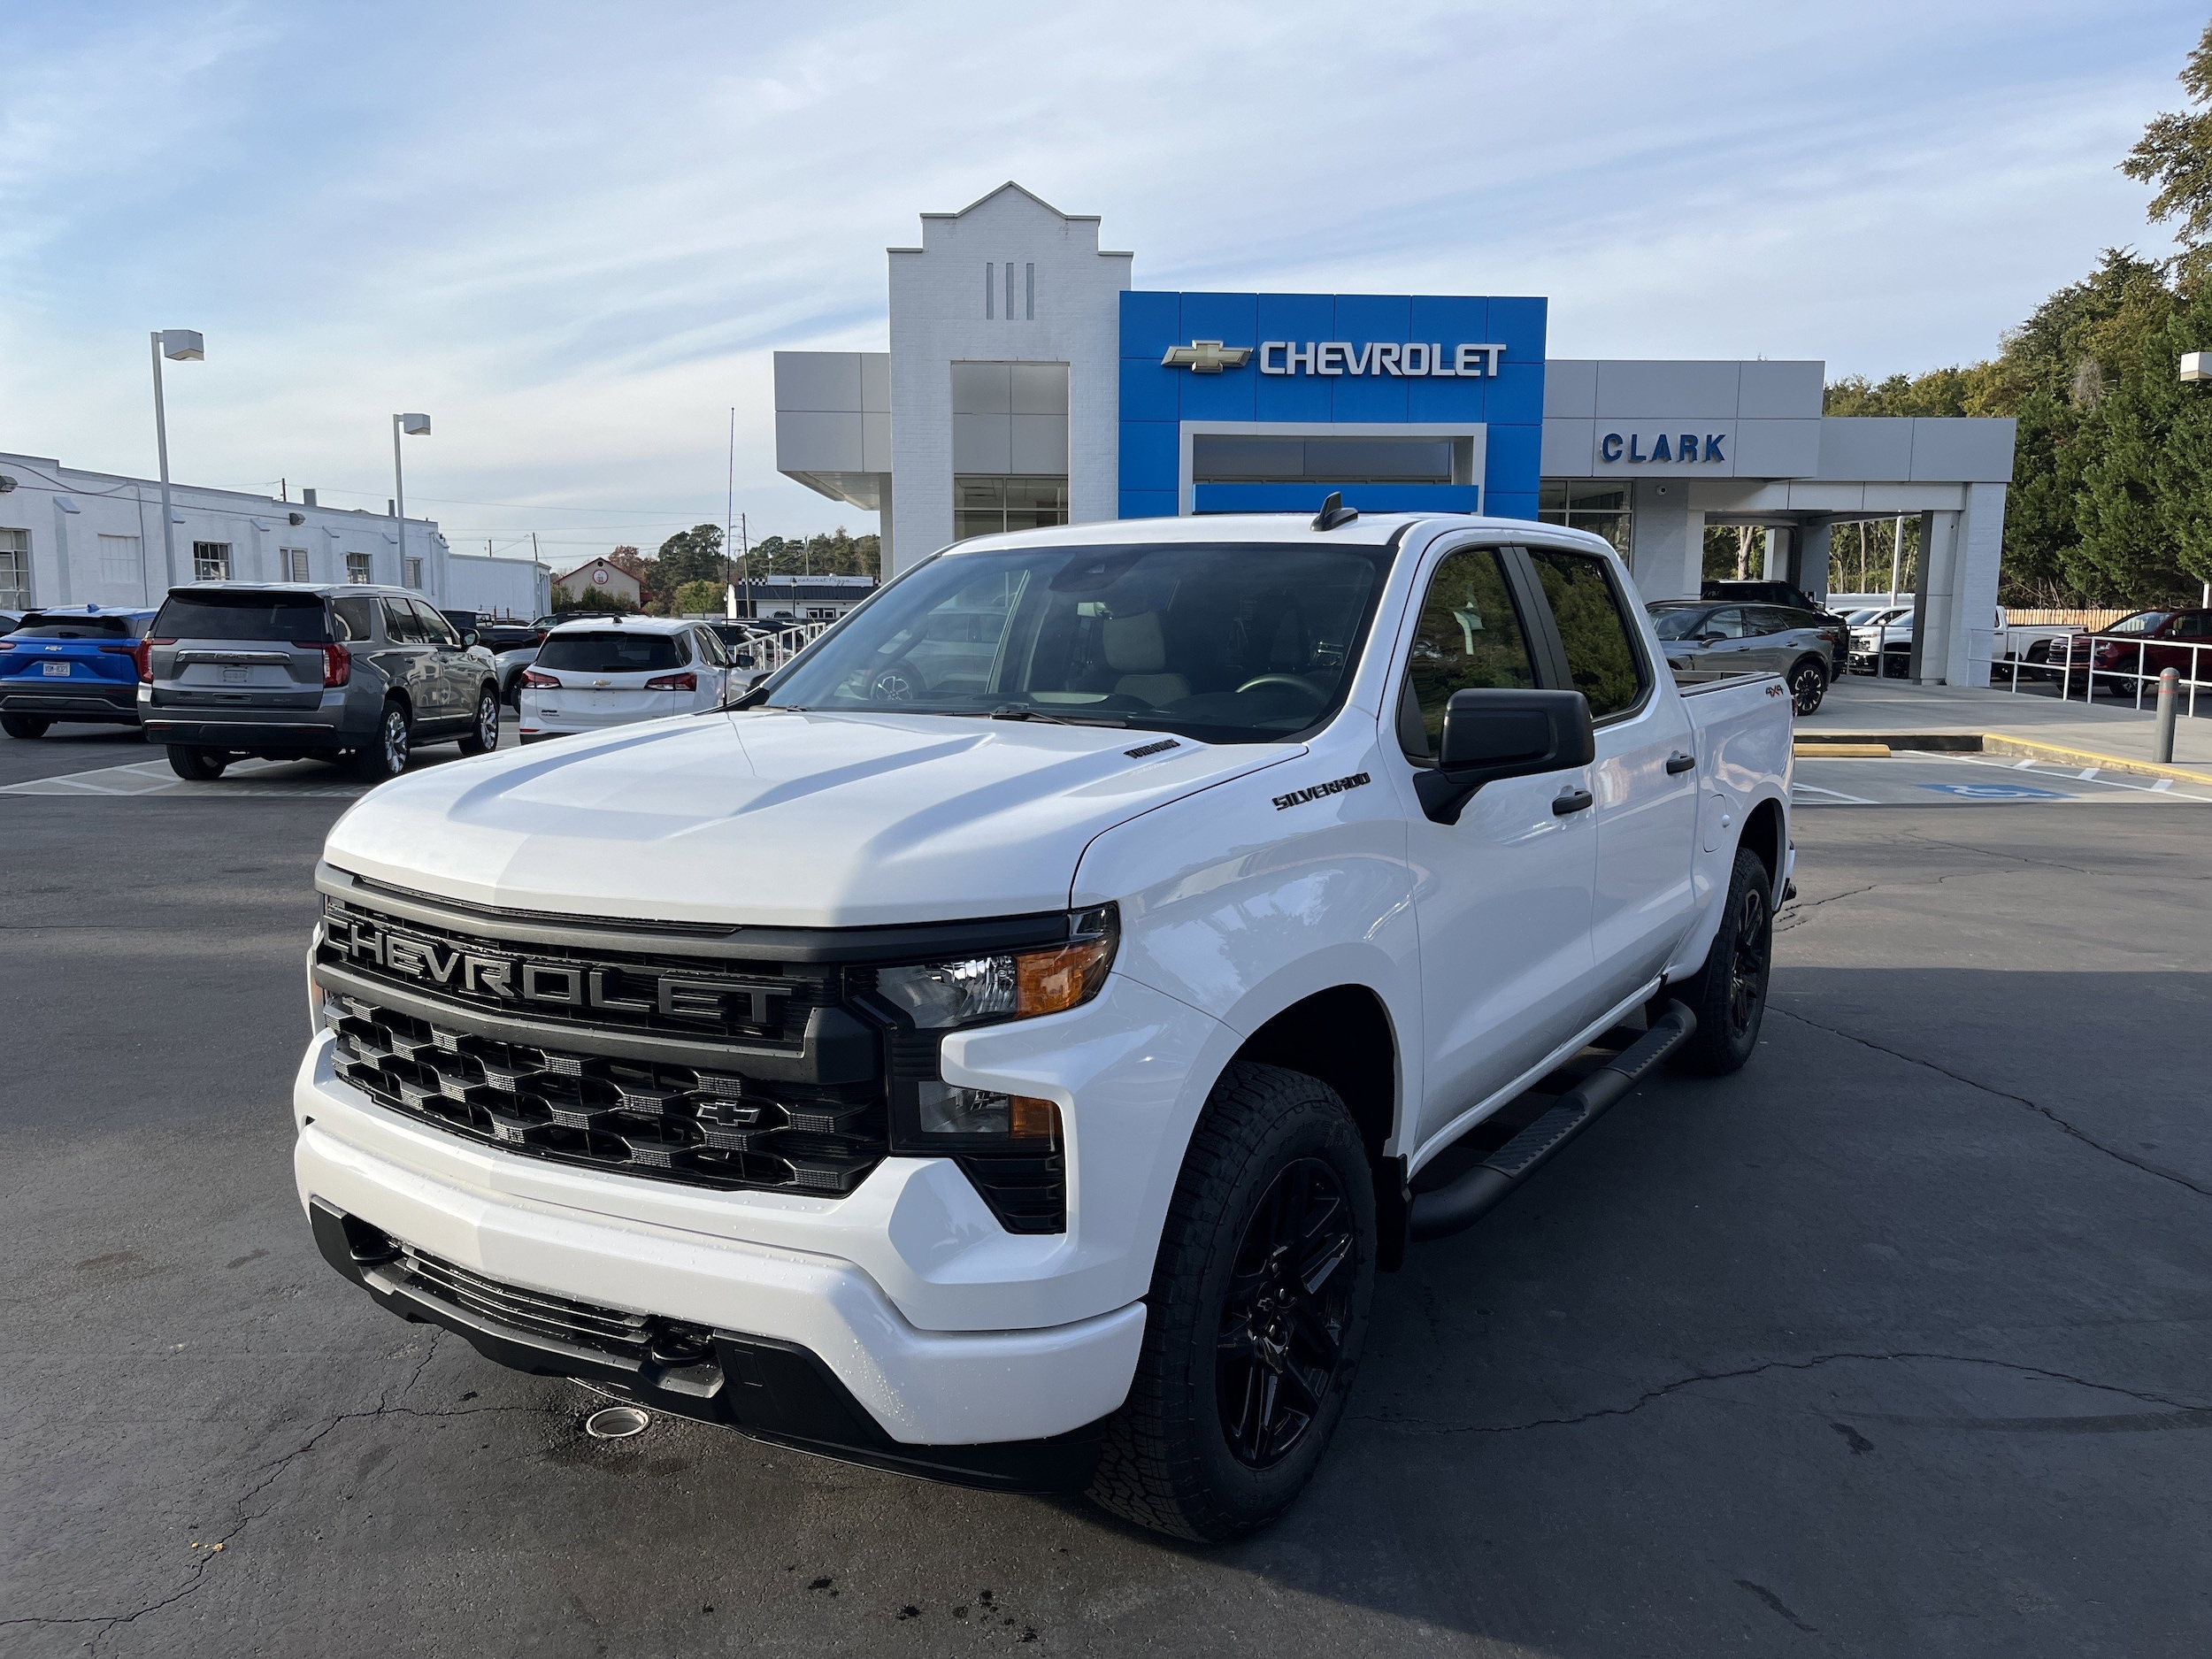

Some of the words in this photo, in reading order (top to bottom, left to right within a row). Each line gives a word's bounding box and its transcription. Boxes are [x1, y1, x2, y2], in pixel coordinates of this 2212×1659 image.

[1260, 341, 1507, 376] CHEVROLET
[1601, 433, 1726, 463] CLARK
[1271, 772, 1371, 811] SILVERADO
[322, 913, 795, 1025] CHEVROLET
